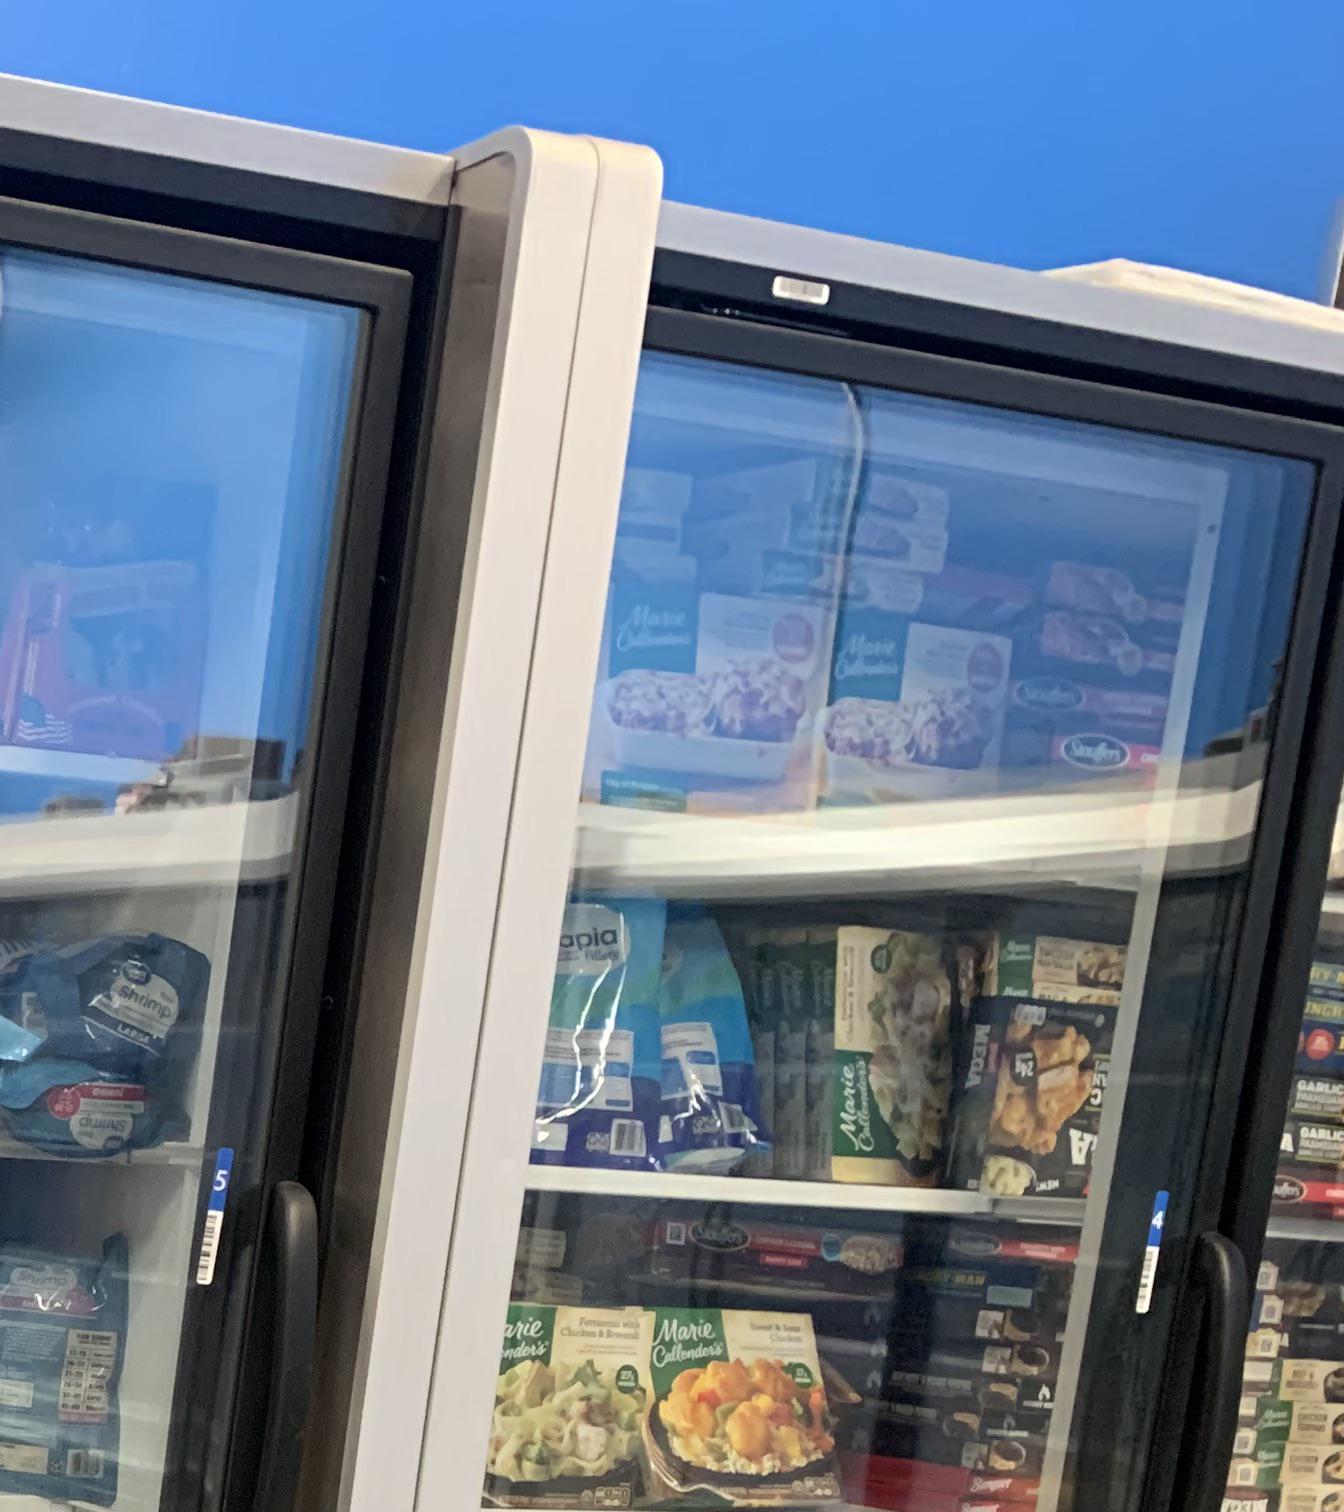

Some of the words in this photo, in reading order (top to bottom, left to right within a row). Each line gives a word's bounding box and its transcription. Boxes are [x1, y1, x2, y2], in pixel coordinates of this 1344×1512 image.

[118, 984, 173, 1019] shrimp
[839, 1064, 860, 1151] Marie
[854, 1056, 875, 1152] Callender's
[213, 1170, 228, 1191] 5
[1152, 1210, 1164, 1230] 4
[653, 1318, 716, 1347] Marie
[652, 1341, 724, 1368] Callender's
